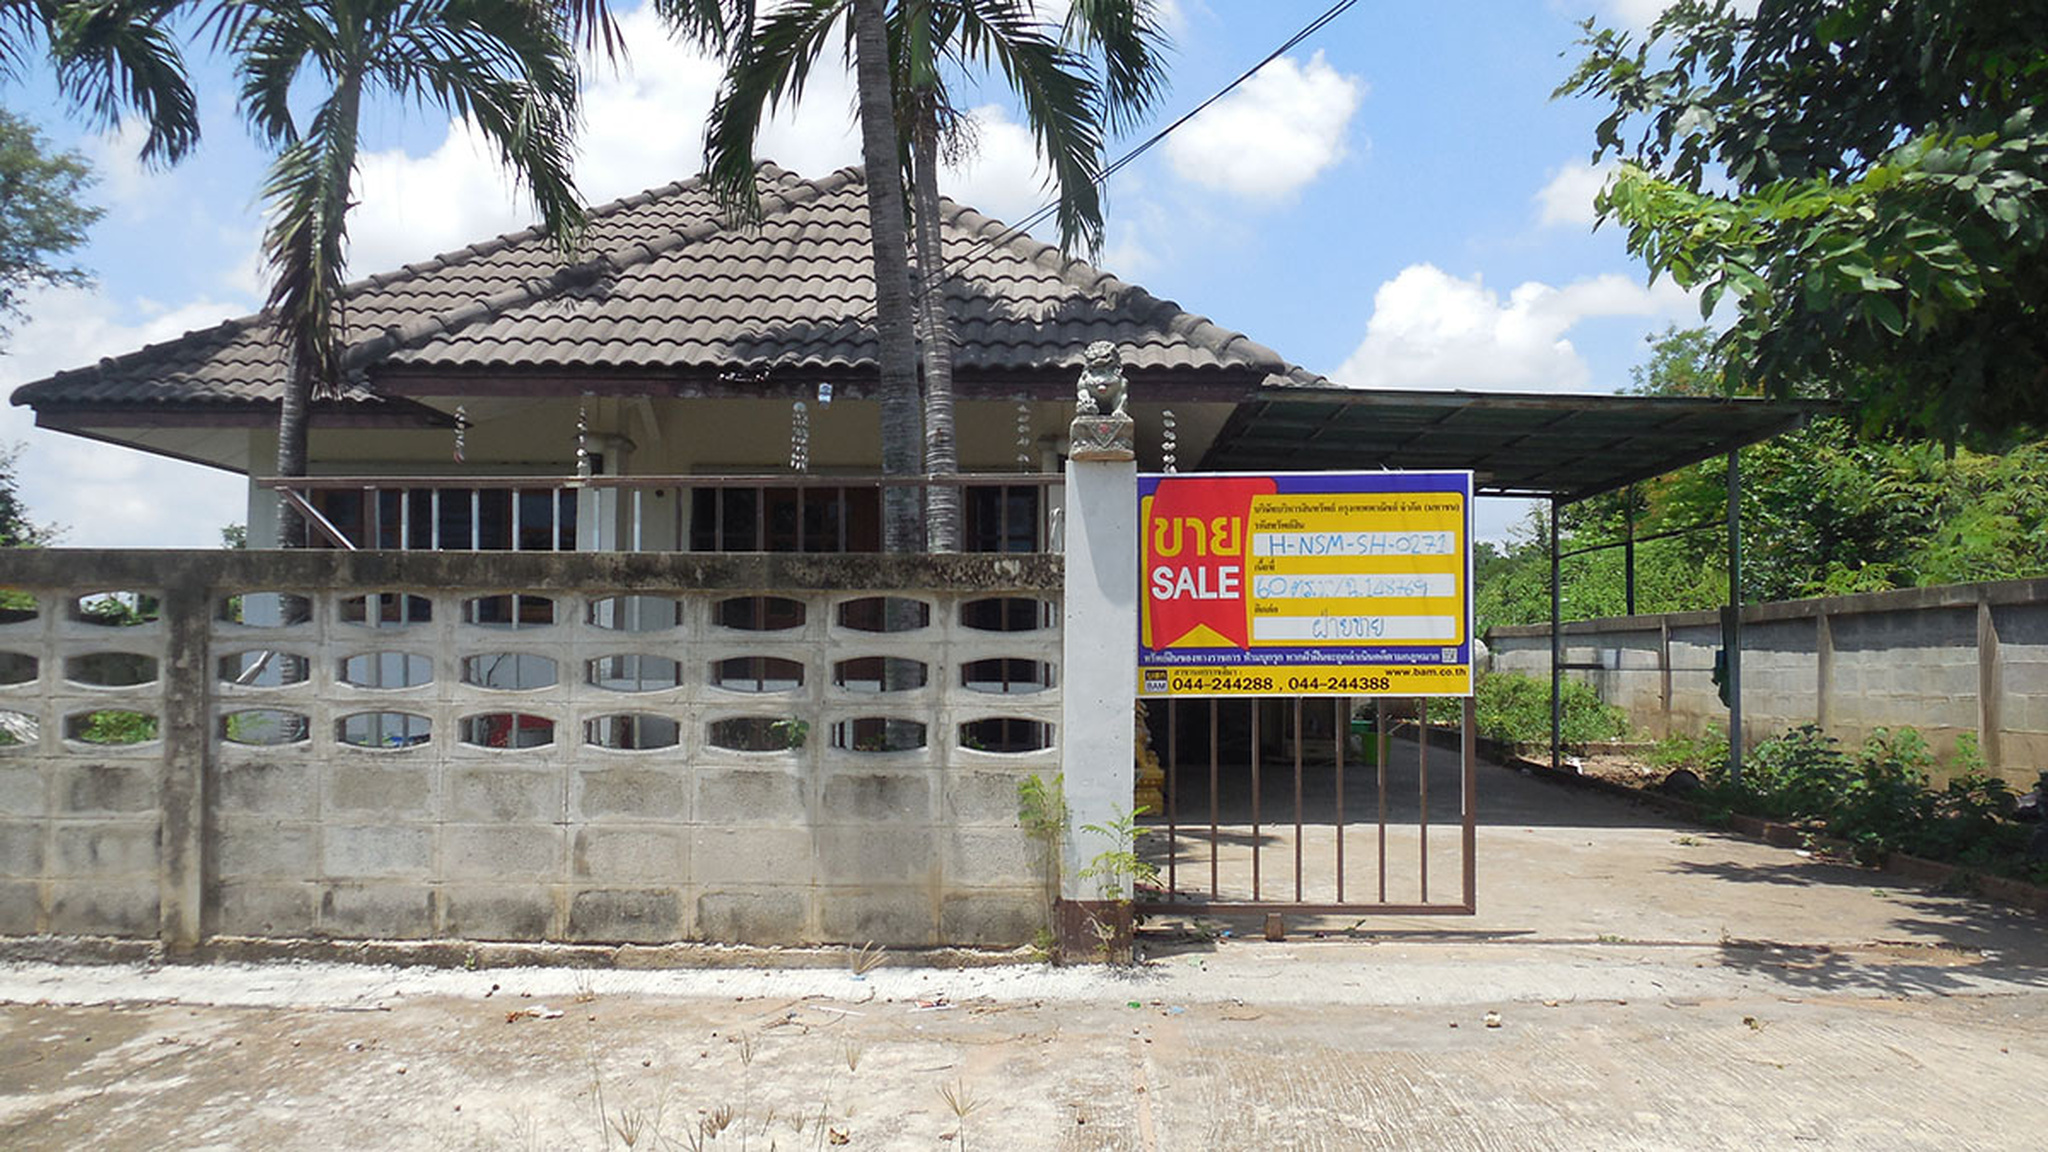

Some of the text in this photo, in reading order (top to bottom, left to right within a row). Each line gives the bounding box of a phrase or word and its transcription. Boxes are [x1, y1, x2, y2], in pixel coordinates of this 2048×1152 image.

[1154, 516, 1241, 556] ขาย
[1151, 565, 1240, 600] SALE
[1172, 677, 1273, 691] 044-244288
[1288, 676, 1391, 691] 044-244388
[1385, 667, 1467, 677] www.bam.co.th
